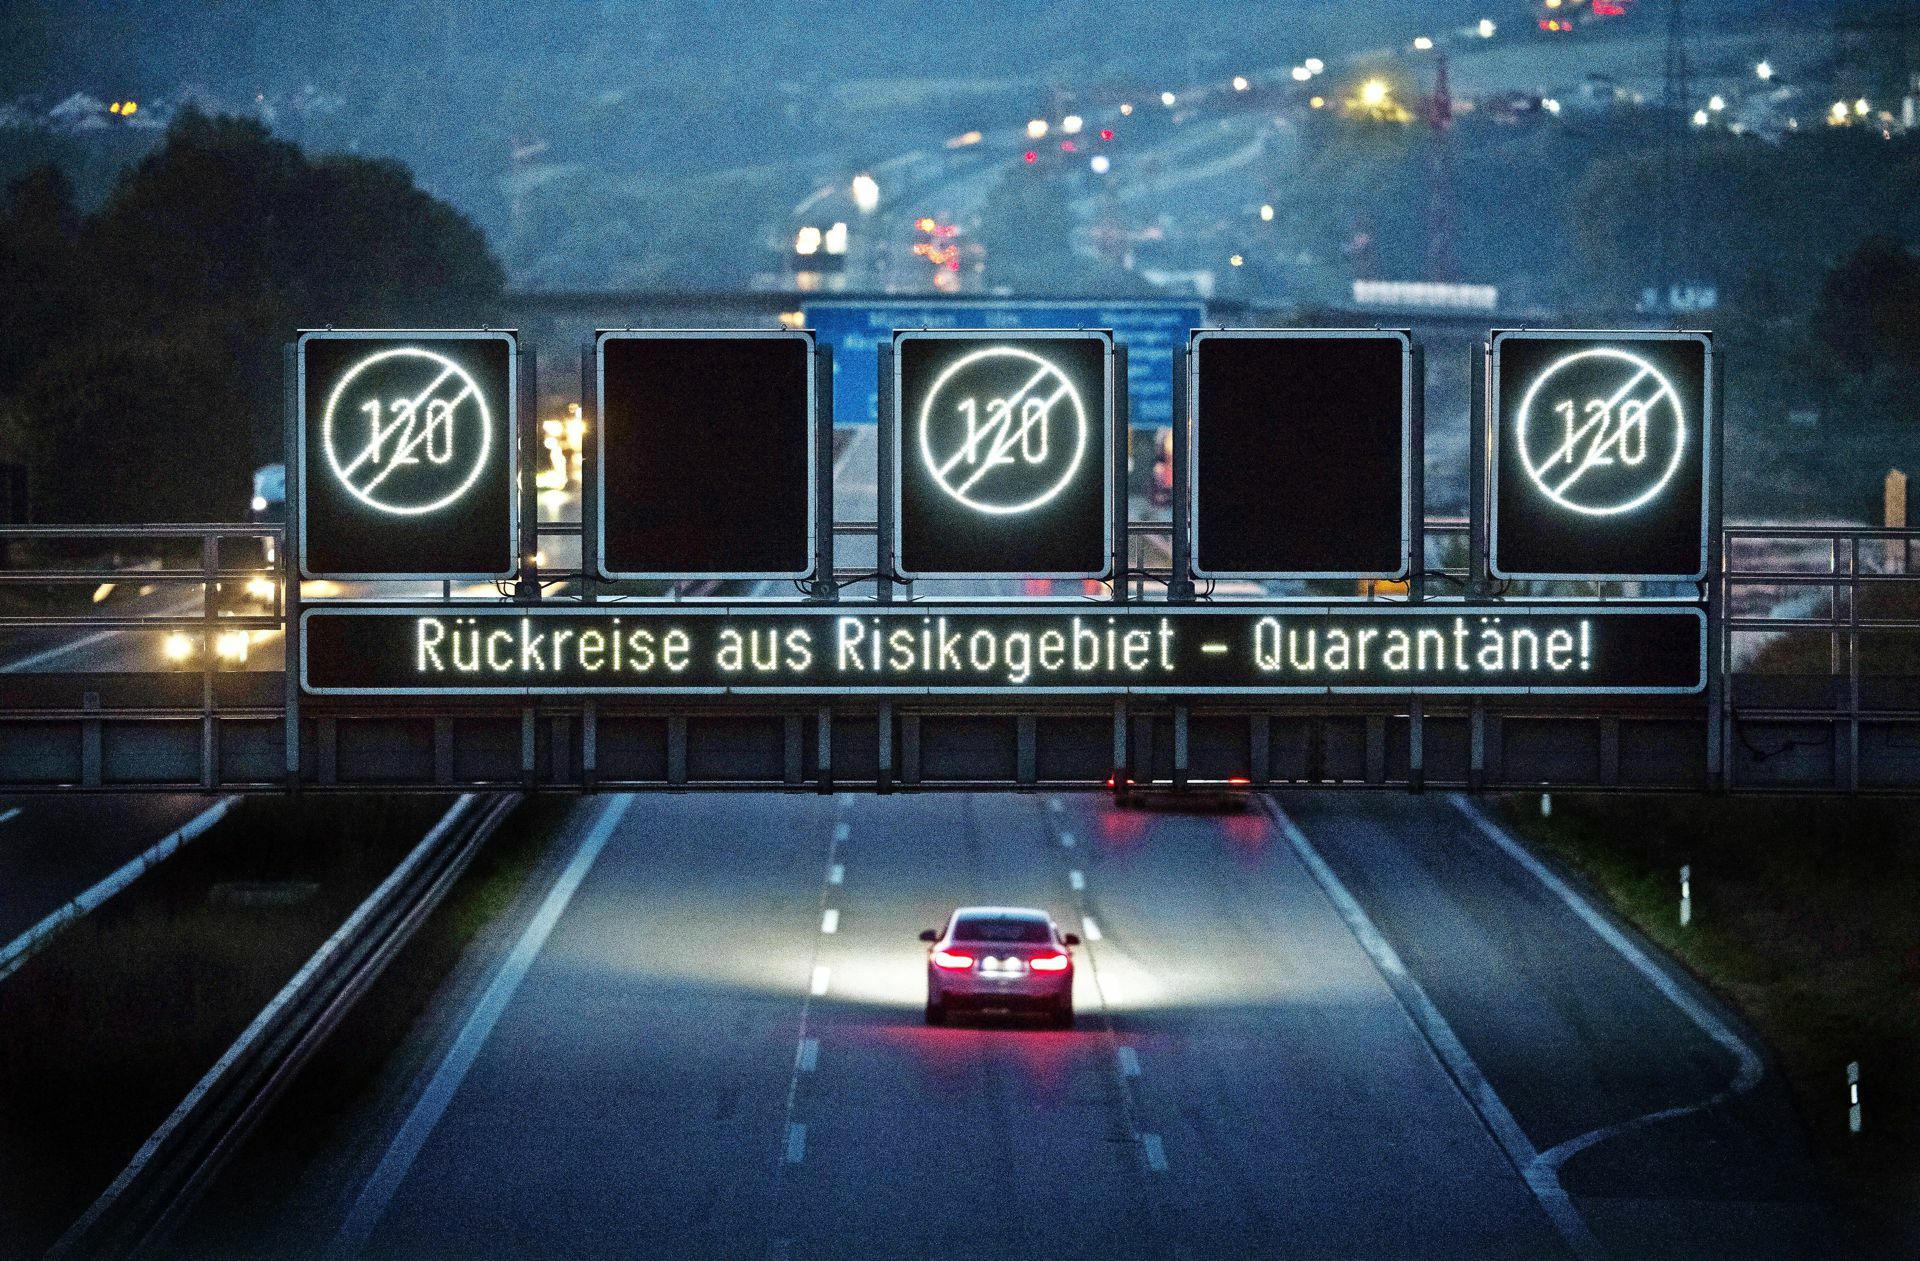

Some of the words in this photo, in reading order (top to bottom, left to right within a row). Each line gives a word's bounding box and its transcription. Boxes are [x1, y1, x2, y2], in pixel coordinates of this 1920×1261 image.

[360, 396, 454, 465] 120
[955, 396, 1050, 465] 120
[1552, 396, 1648, 465] 120
[416, 616, 692, 673] Rückreise
[716, 627, 813, 673] aus
[836, 616, 1175, 684] Risikogebiet
[1253, 616, 1592, 672] Quarantäne!
